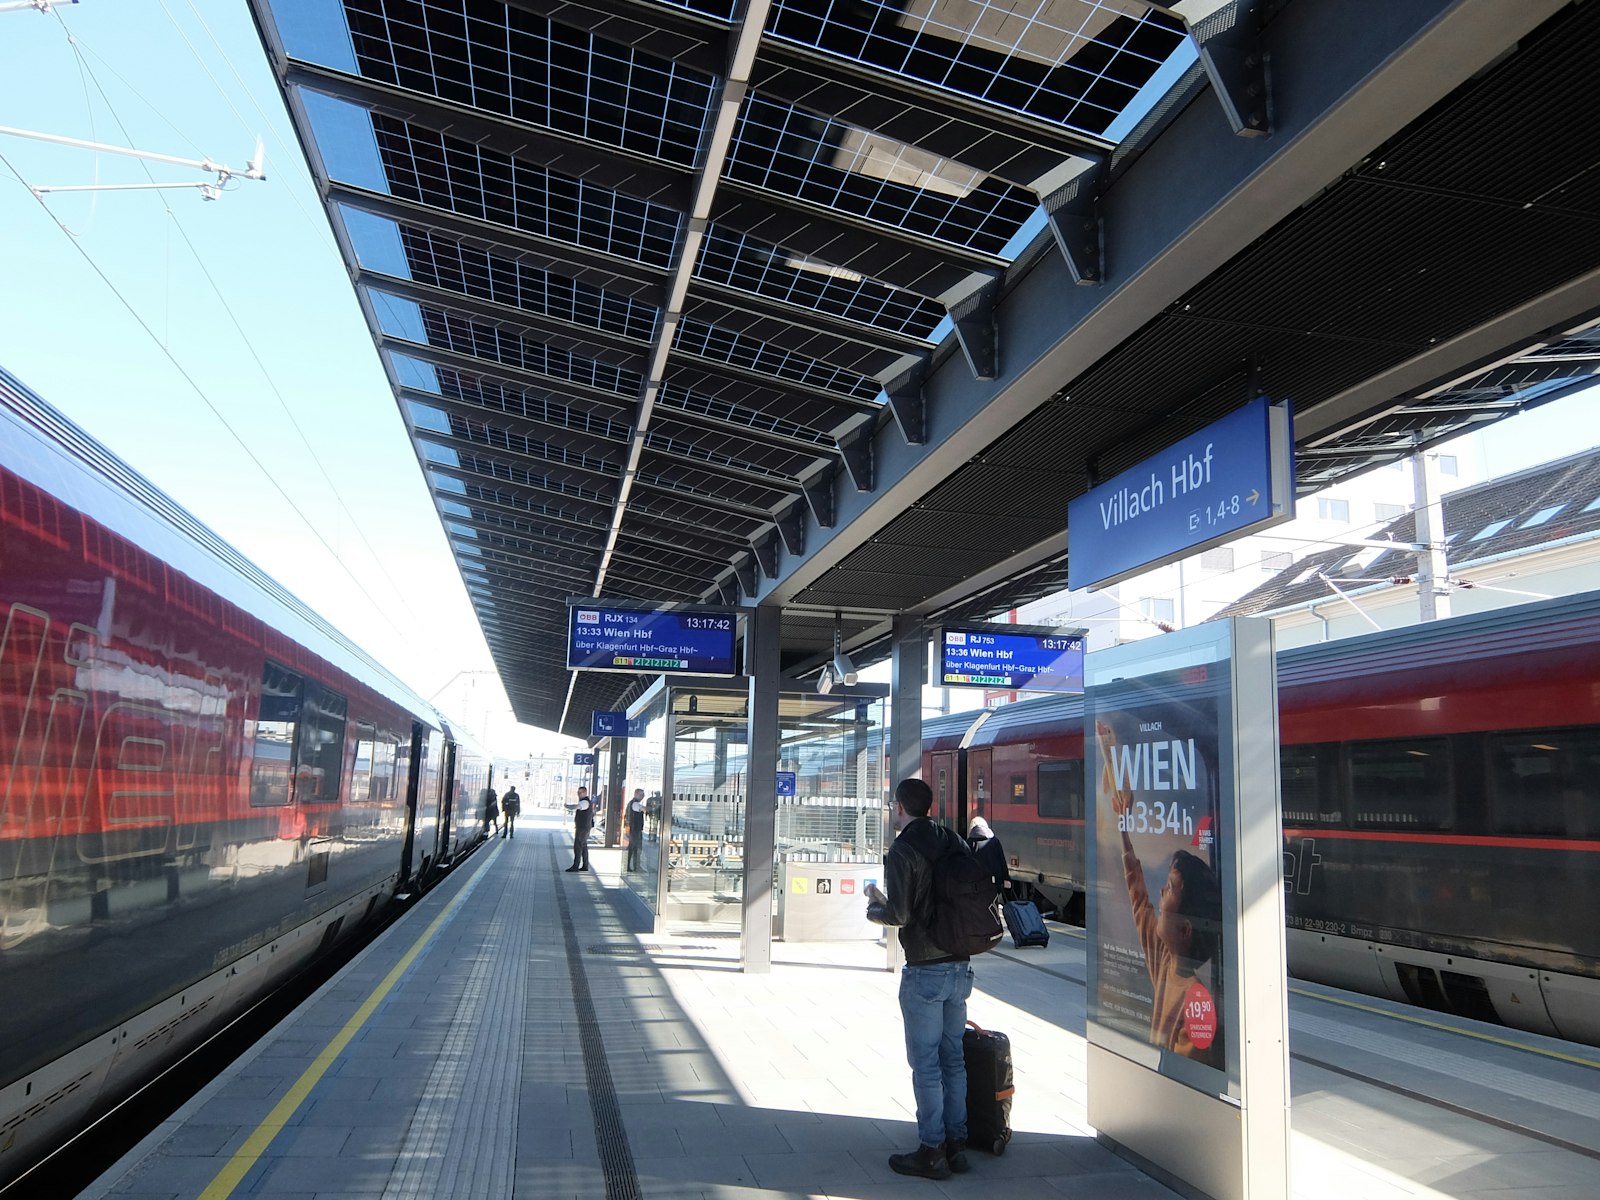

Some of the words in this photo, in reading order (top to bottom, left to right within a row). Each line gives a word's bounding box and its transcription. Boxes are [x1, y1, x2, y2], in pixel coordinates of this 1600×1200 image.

[1100, 473, 1163, 530] Villach
[1172, 443, 1213, 498] Hbf
[1205, 495, 1240, 526] 1,4-8
[604, 614, 623, 623] RJX
[625, 616, 638, 624] 134
[686, 618, 730, 630] 13:17:42
[576, 627, 602, 636] 13:33
[603, 628, 630, 638] Wien
[634, 630, 652, 639] Hbf
[970, 635, 982, 644] RJ
[982, 637, 994, 645] 753
[1042, 639, 1081, 650] 13:17:42
[576, 641, 595, 649] über
[597, 642, 637, 652] Klagenfurt
[946, 648, 968, 656] 13:36
[970, 649, 993, 658] Wien
[996, 650, 1013, 659] Hbf
[964, 661, 1000, 670] Klagenfurt
[1139, 721, 1162, 733] VILLACH
[576, 755, 582, 764] 3
[1110, 738, 1196, 790] WIEN
